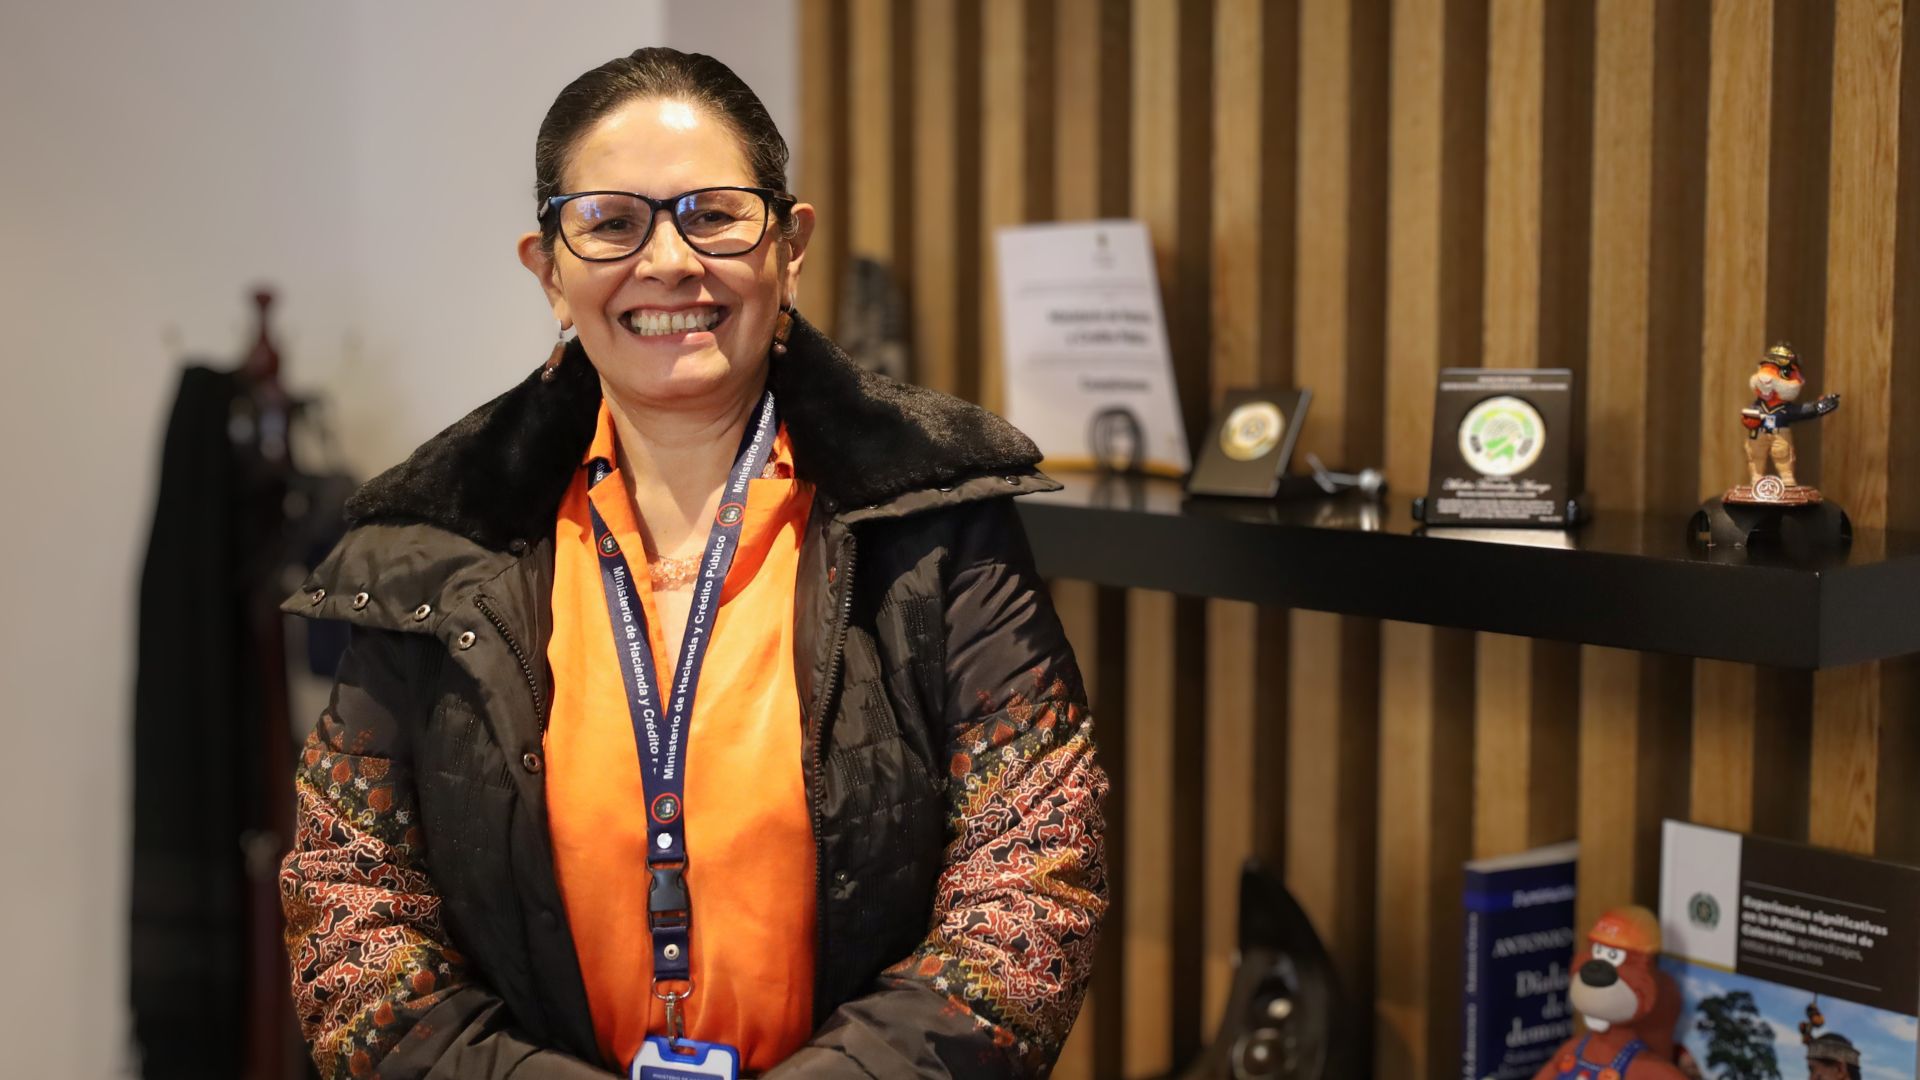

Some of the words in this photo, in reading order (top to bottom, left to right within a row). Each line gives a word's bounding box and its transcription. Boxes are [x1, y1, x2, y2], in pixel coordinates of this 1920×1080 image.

[732, 444, 759, 493] Ministerio
[753, 430, 765, 442] de
[705, 535, 726, 578] Público
[613, 566, 633, 622] Ministerio
[694, 580, 713, 624] Crédito
[625, 625, 637, 639] de
[629, 641, 649, 696] Hacienda
[677, 637, 699, 693] Hacienda
[674, 697, 684, 712] de
[643, 708, 660, 754] Crédito
[663, 715, 681, 779] Ministerio
[1741, 911, 1757, 923] en
[1757, 912, 1769, 926] la
[1808, 923, 1857, 944] Nacional
[1858, 935, 1874, 948] de
[1742, 895, 1811, 920] Experiencias
[1812, 910, 1888, 936] significativas
